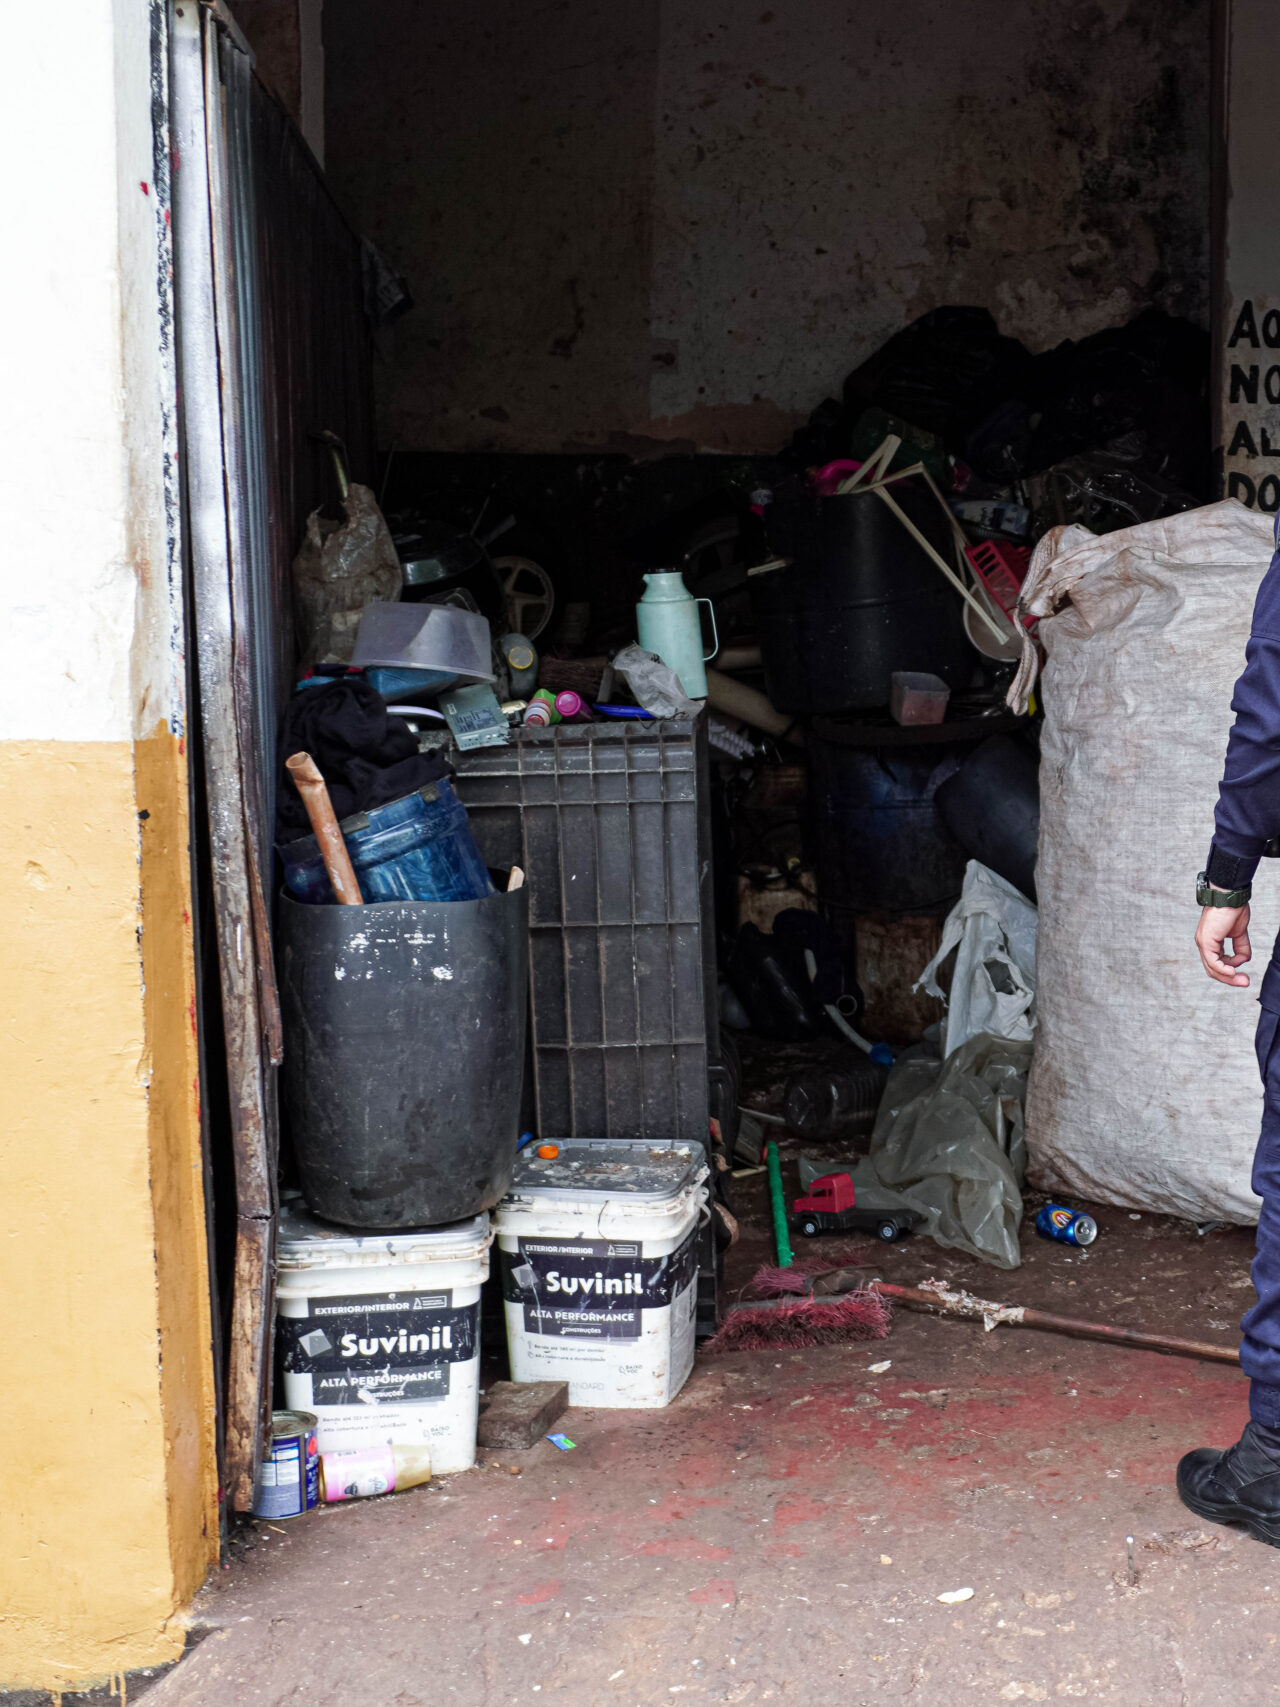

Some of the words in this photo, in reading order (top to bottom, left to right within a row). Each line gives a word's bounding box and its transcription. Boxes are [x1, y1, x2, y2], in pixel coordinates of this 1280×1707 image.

[525, 1244, 594, 1255] EXTERIOR/INTERIOR
[545, 1271, 644, 1295] Suvinil
[314, 1302, 410, 1316] EXTERIOR/INTERIOR
[529, 1309, 553, 1319] ALTA
[554, 1310, 635, 1322] PERFORMANCE
[341, 1325, 453, 1357] Suvinil
[320, 1377, 348, 1388] ALTA
[350, 1370, 442, 1387] PERFORMANCE
